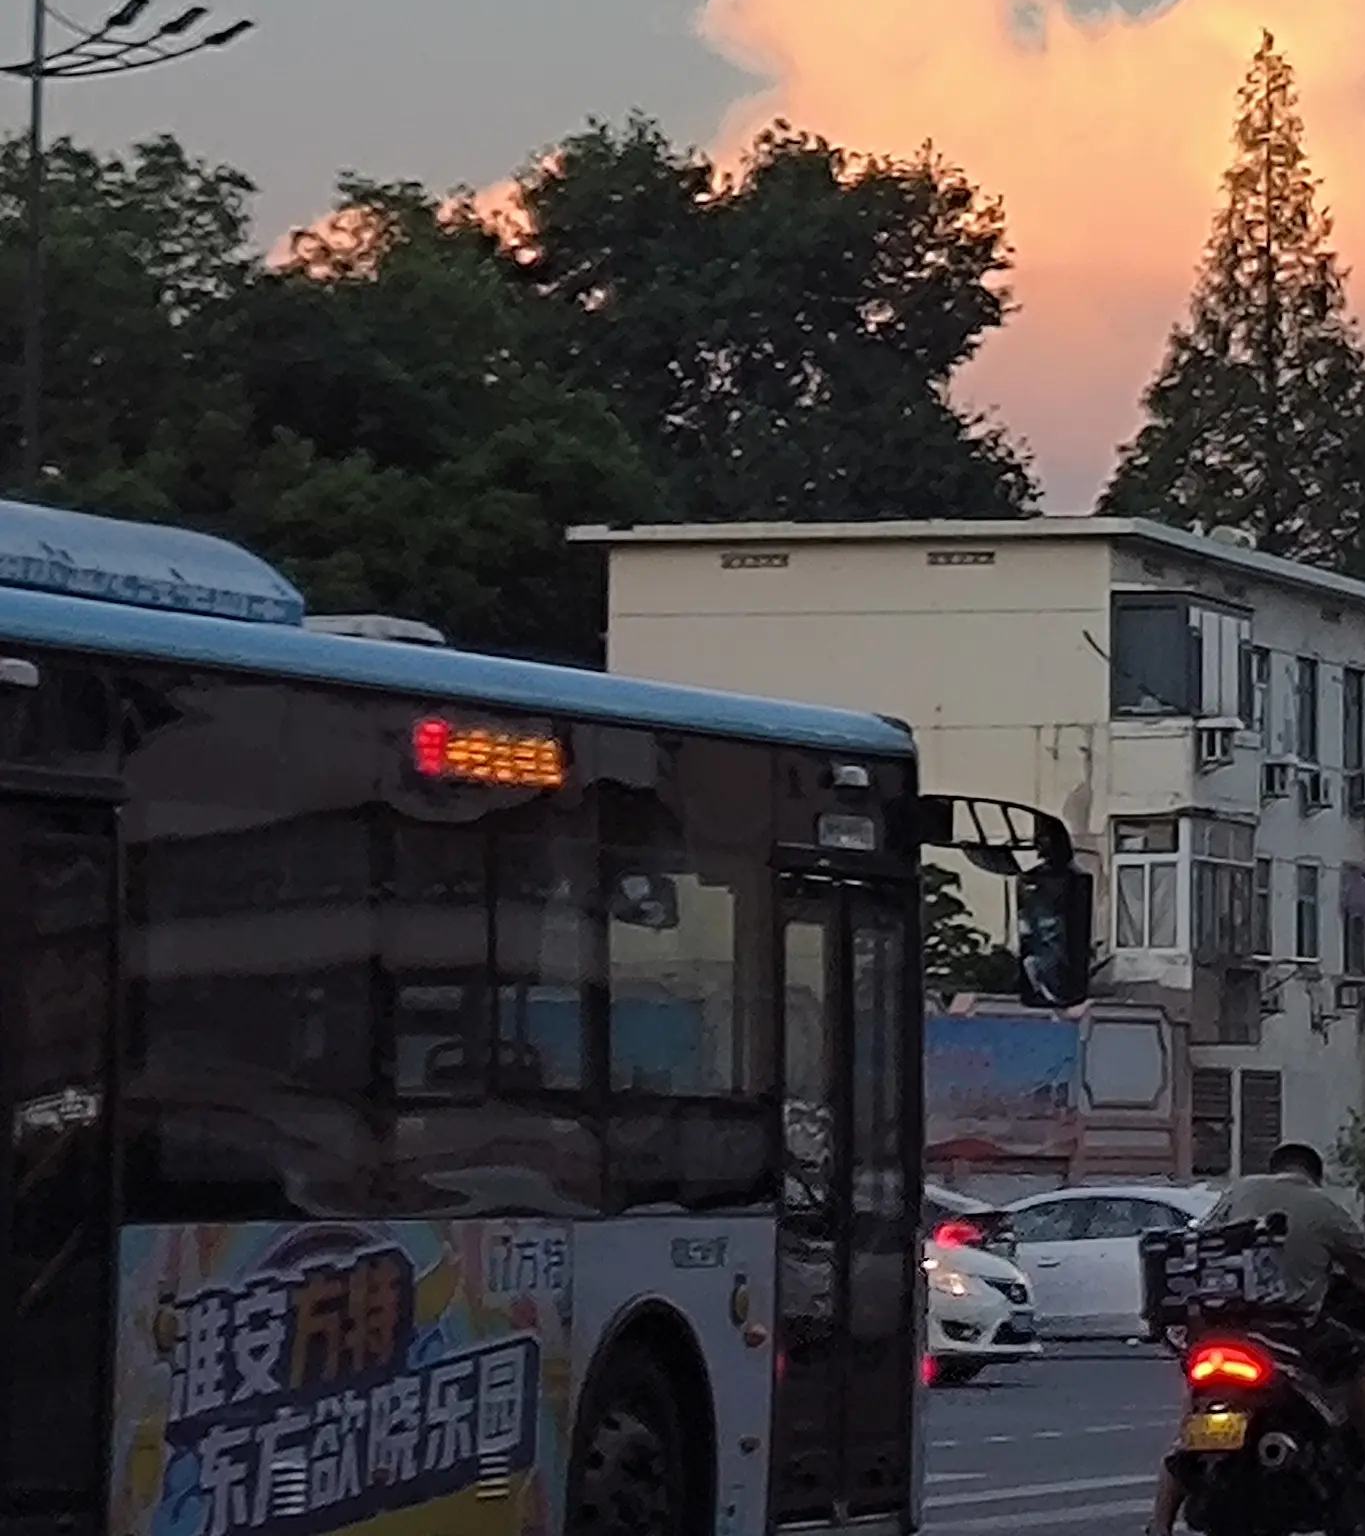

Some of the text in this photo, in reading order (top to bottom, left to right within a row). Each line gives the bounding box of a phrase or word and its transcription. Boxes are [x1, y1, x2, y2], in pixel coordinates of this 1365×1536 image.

[169, 1254, 400, 1421] 淮安方特
[199, 1346, 524, 1536] 东方欲晓乐园
